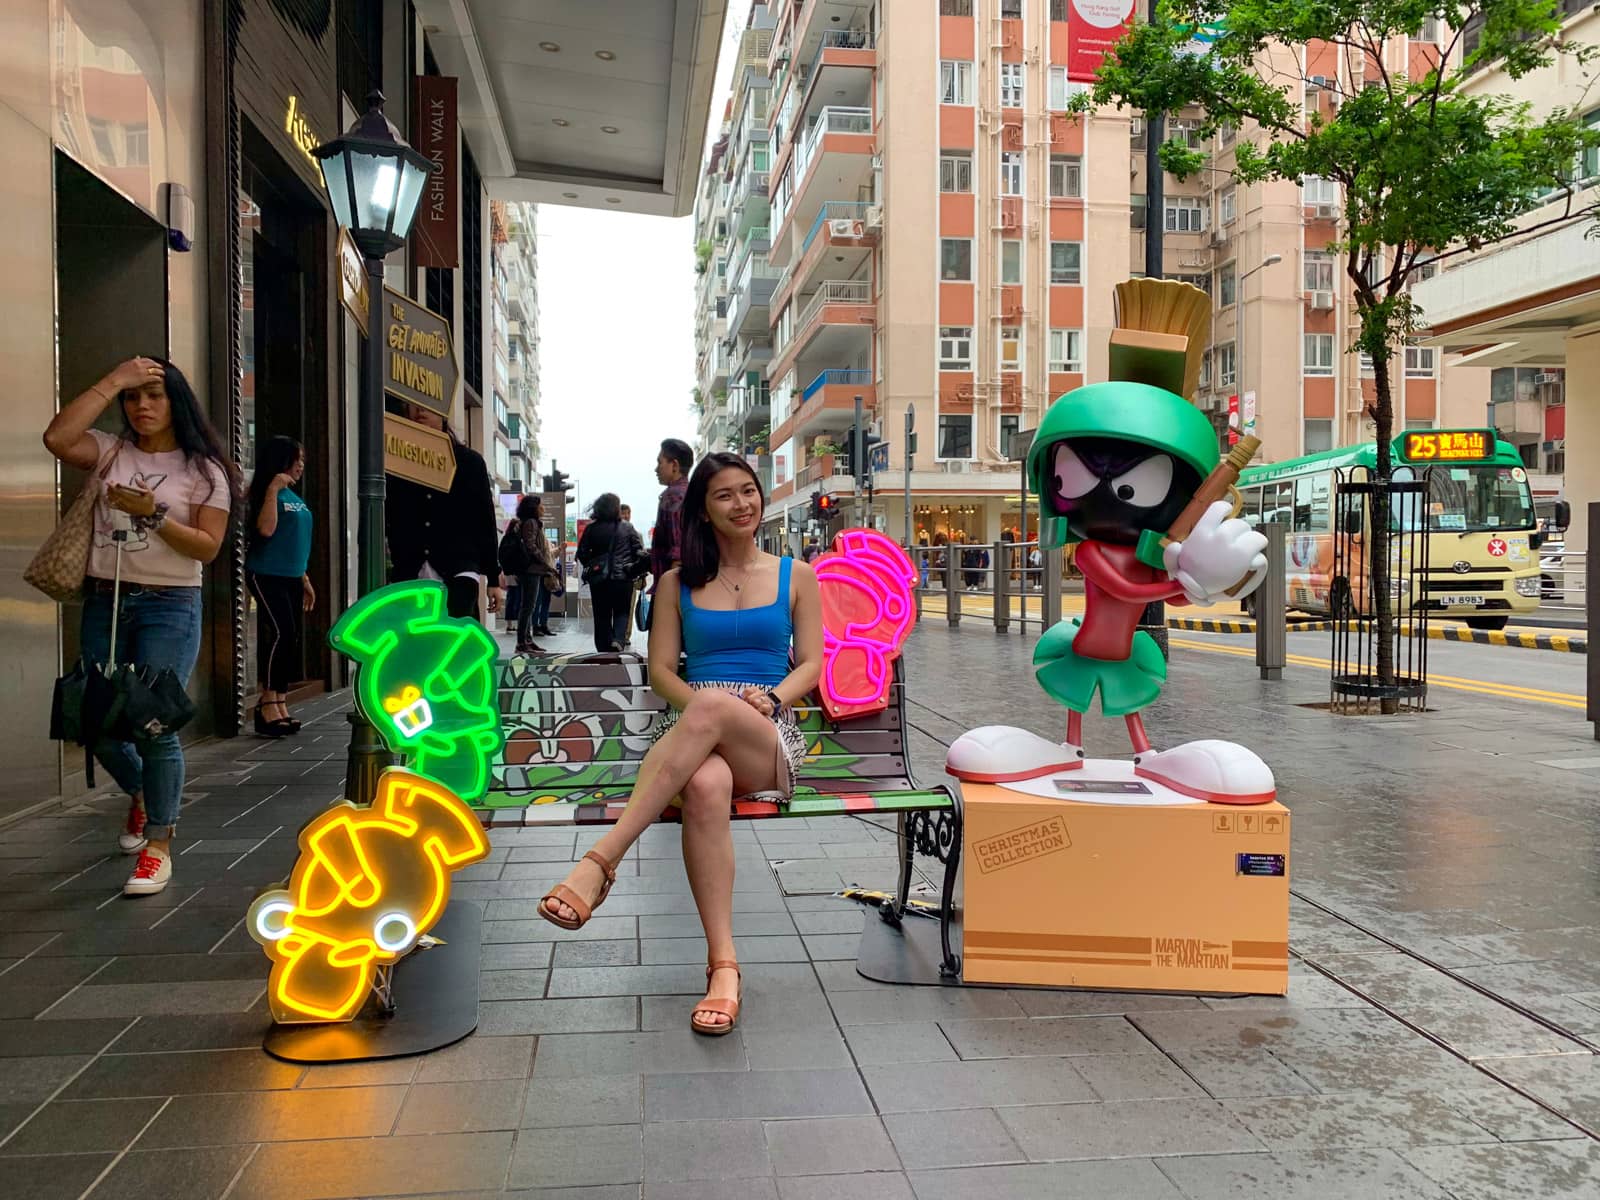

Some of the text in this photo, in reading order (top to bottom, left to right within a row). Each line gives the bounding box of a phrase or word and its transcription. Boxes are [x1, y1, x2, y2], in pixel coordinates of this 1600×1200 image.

[431, 98, 444, 221] FASHION WALK
[392, 303, 405, 321] THE
[388, 324, 448, 359] GET ANIMATED
[392, 351, 443, 401] INVASION
[385, 433, 435, 468] KINGSTON
[1410, 434, 1436, 457] 25
[1442, 595, 1483, 604] LN 8983
[978, 822, 1060, 856] CHRISTMAS
[983, 834, 1064, 868] COLLECTION
[1155, 938, 1200, 953] MARVIN
[1156, 953, 1229, 969] THE MARTIAN
